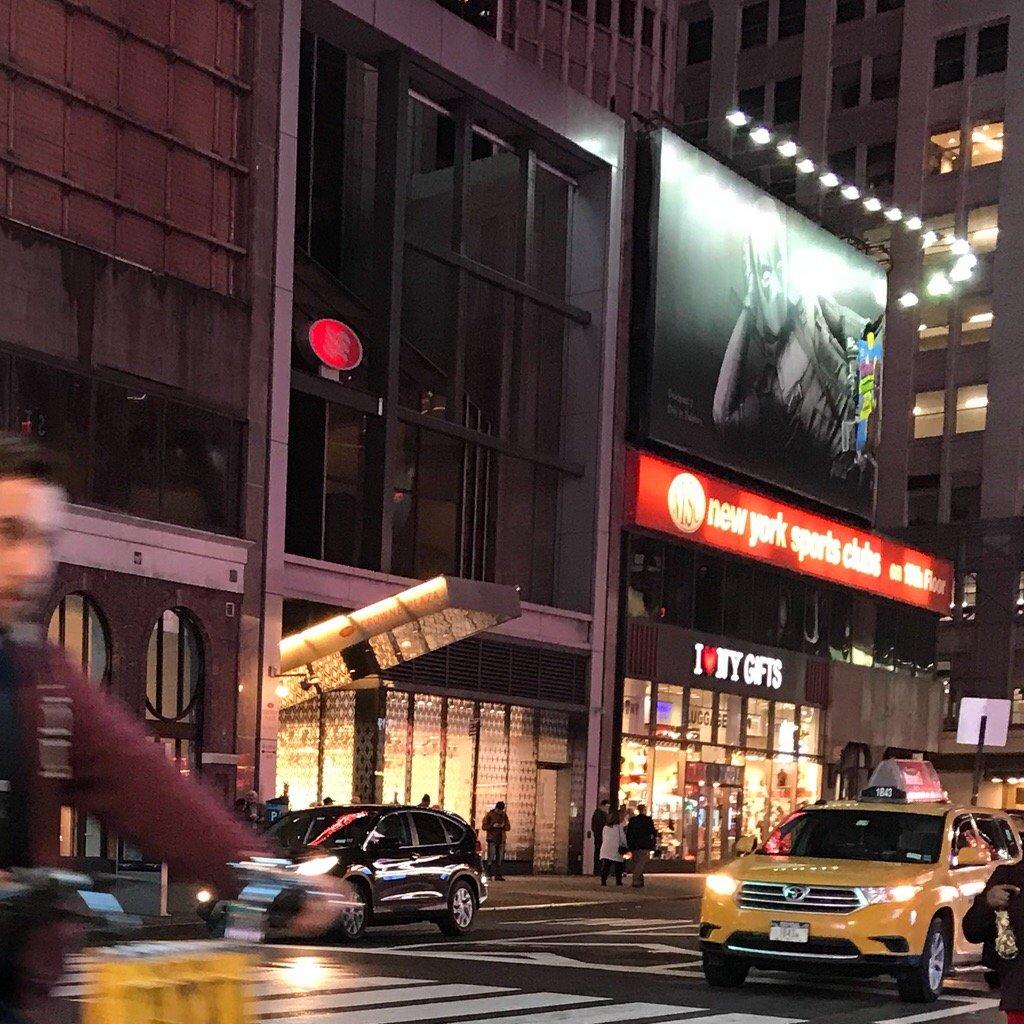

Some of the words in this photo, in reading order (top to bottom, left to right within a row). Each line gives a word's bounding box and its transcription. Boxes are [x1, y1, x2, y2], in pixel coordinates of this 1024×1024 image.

[707, 497, 749, 536] new
[749, 511, 788, 548] york
[790, 525, 841, 562] sports
[842, 537, 882, 578] clubs
[693, 643, 704, 675] I
[715, 647, 743, 681] NY
[743, 653, 783, 689] GIFTS
